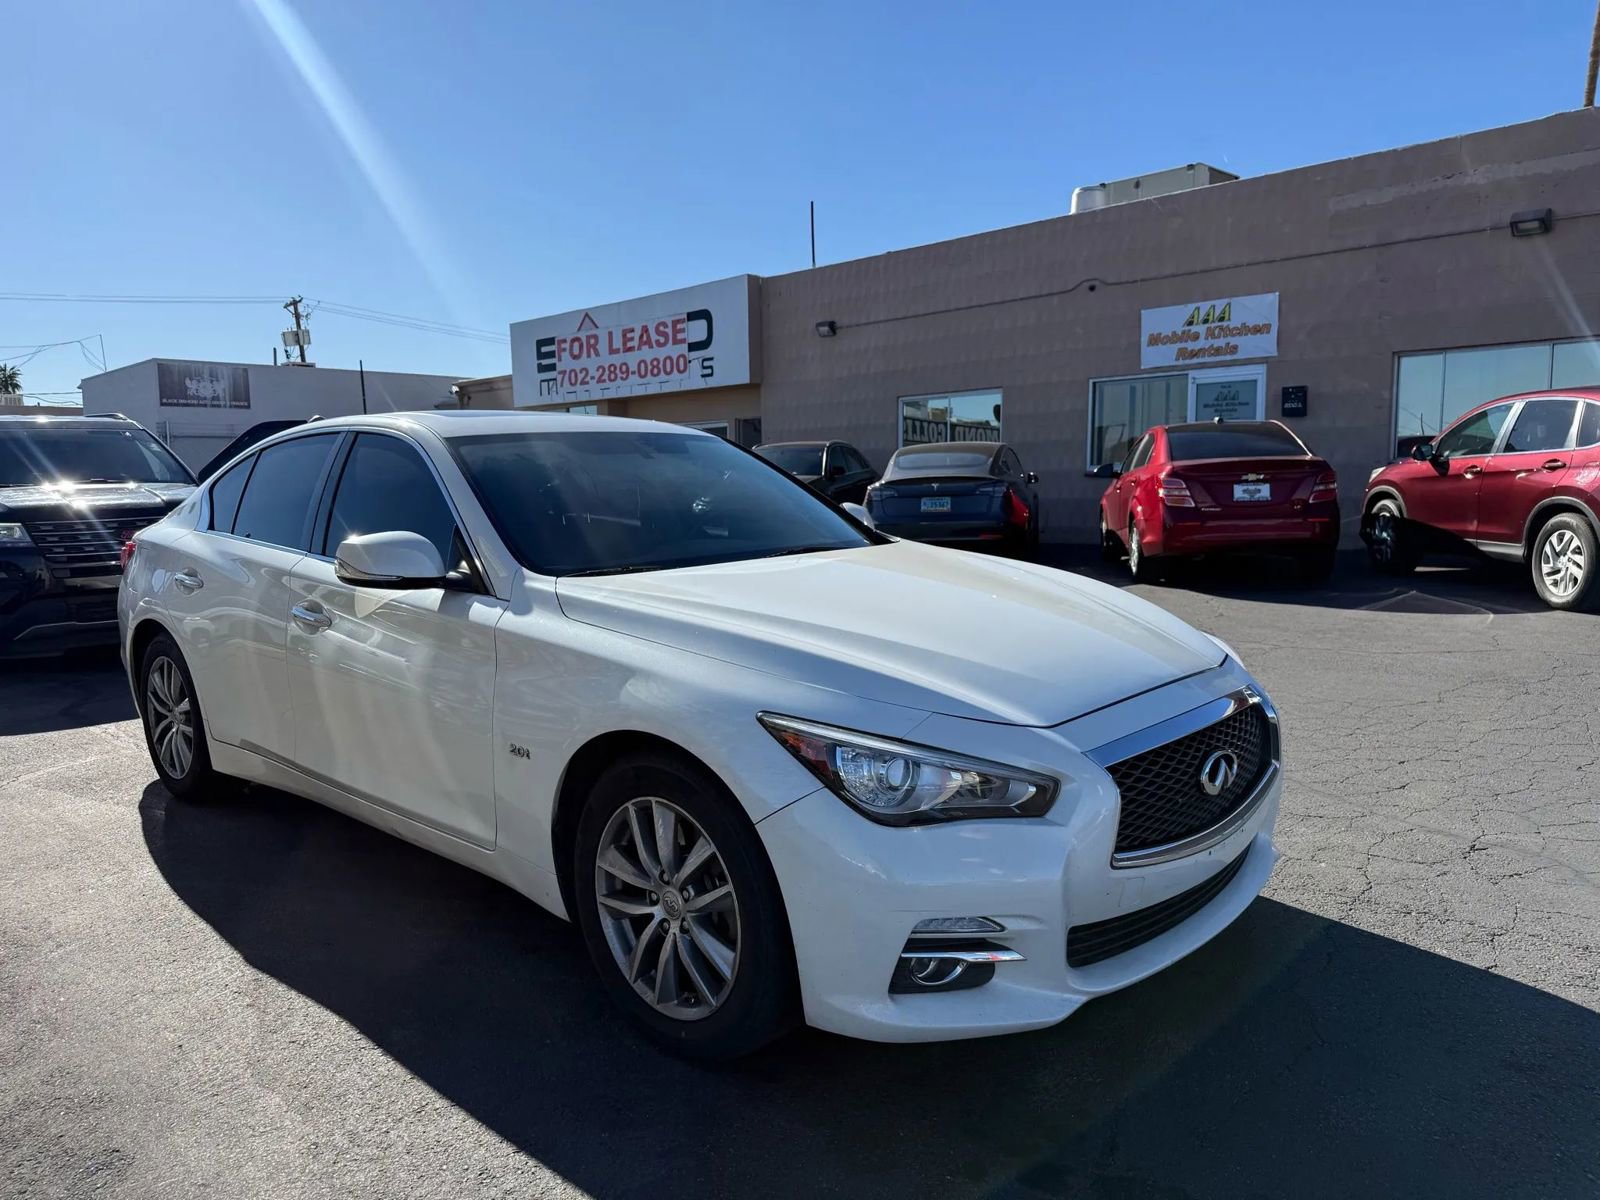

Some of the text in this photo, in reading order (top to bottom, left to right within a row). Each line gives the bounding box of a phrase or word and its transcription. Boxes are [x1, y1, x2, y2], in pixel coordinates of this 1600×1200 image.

[1182, 302, 1231, 327] AAA
[557, 334, 600, 362] FOR
[607, 317, 687, 355] LEASE
[1147, 323, 1272, 347] Mobile Kitchen
[1175, 342, 1239, 361] Rentals
[558, 353, 688, 389] 702-289-0800
